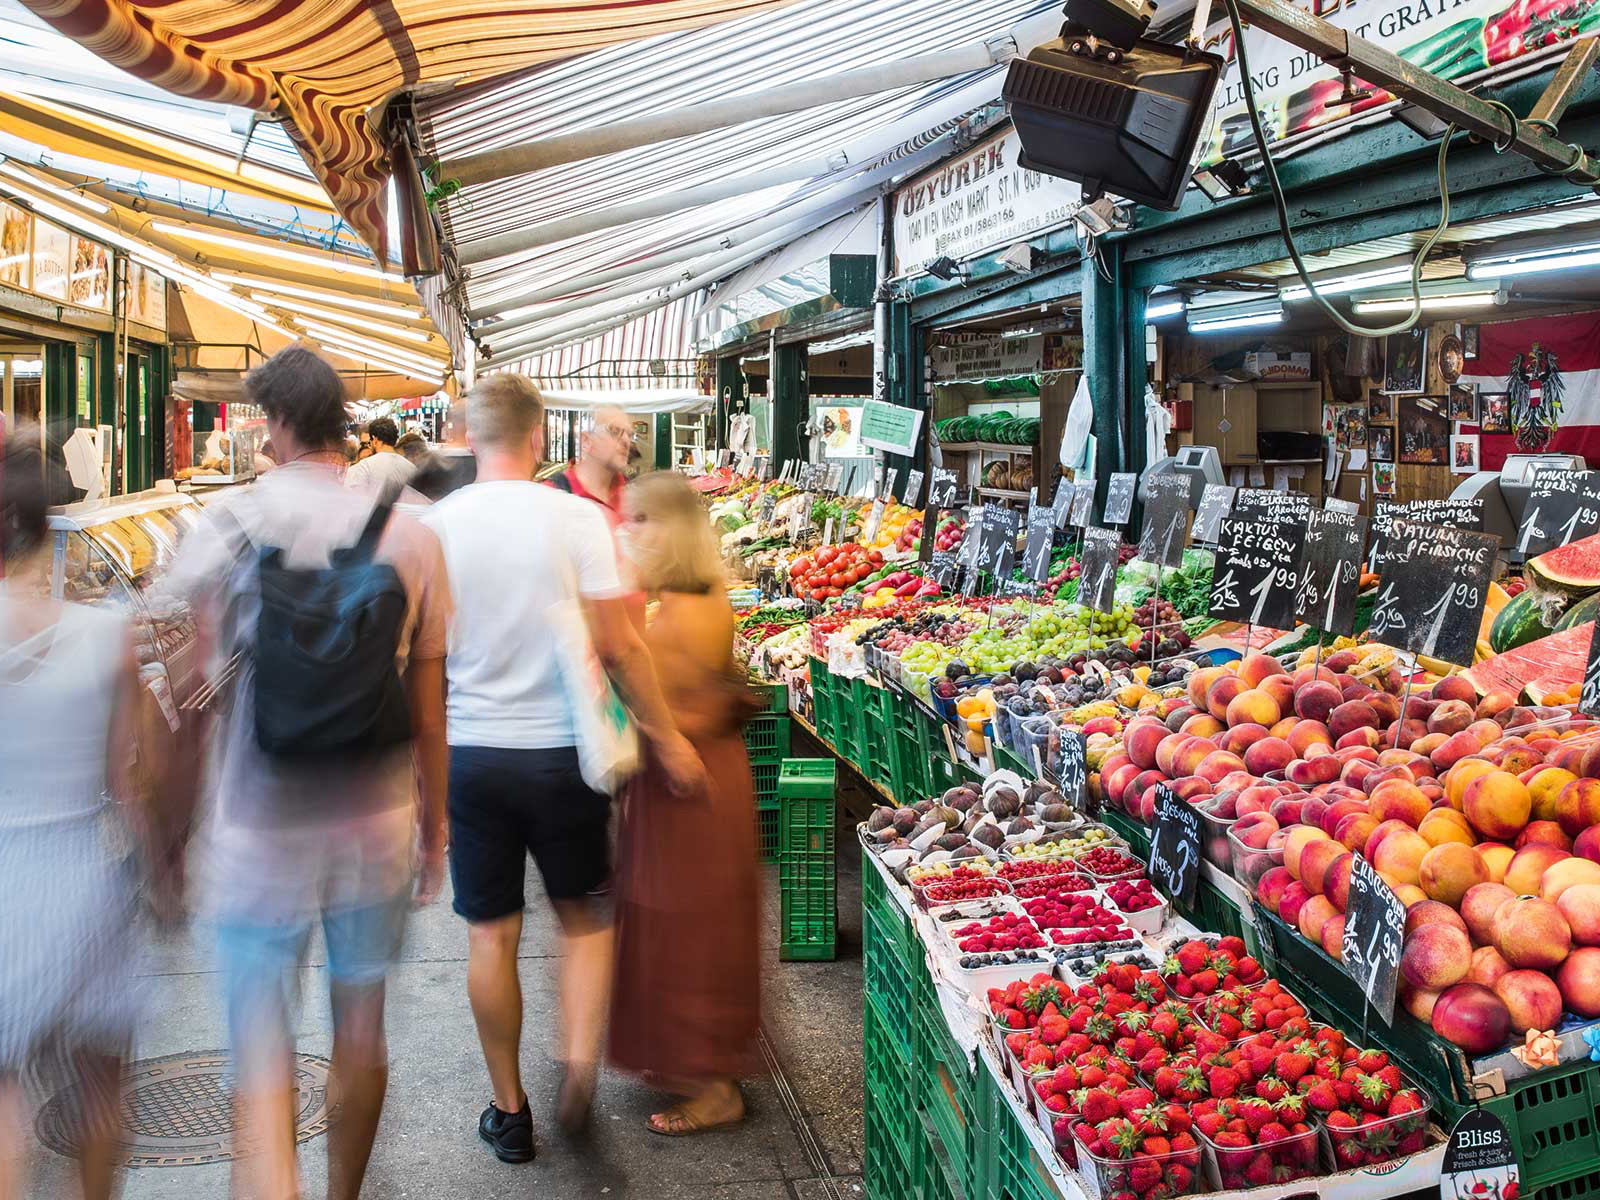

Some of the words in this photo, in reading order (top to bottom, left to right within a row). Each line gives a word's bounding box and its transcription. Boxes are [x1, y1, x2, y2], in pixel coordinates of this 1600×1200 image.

[903, 139, 1006, 218] ÖZYÜREK
[924, 207, 939, 237] WIEN
[941, 196, 964, 230] NASCH
[966, 184, 990, 219] MARKT
[1536, 469, 1595, 481] MUSKAT
[1220, 519, 1280, 538] KAKTUS
[1392, 520, 1460, 545] SATURN
[1456, 1128, 1502, 1149] Bliss
[1453, 1159, 1478, 1169] Frisch
[1457, 1150, 1478, 1161] fresh
